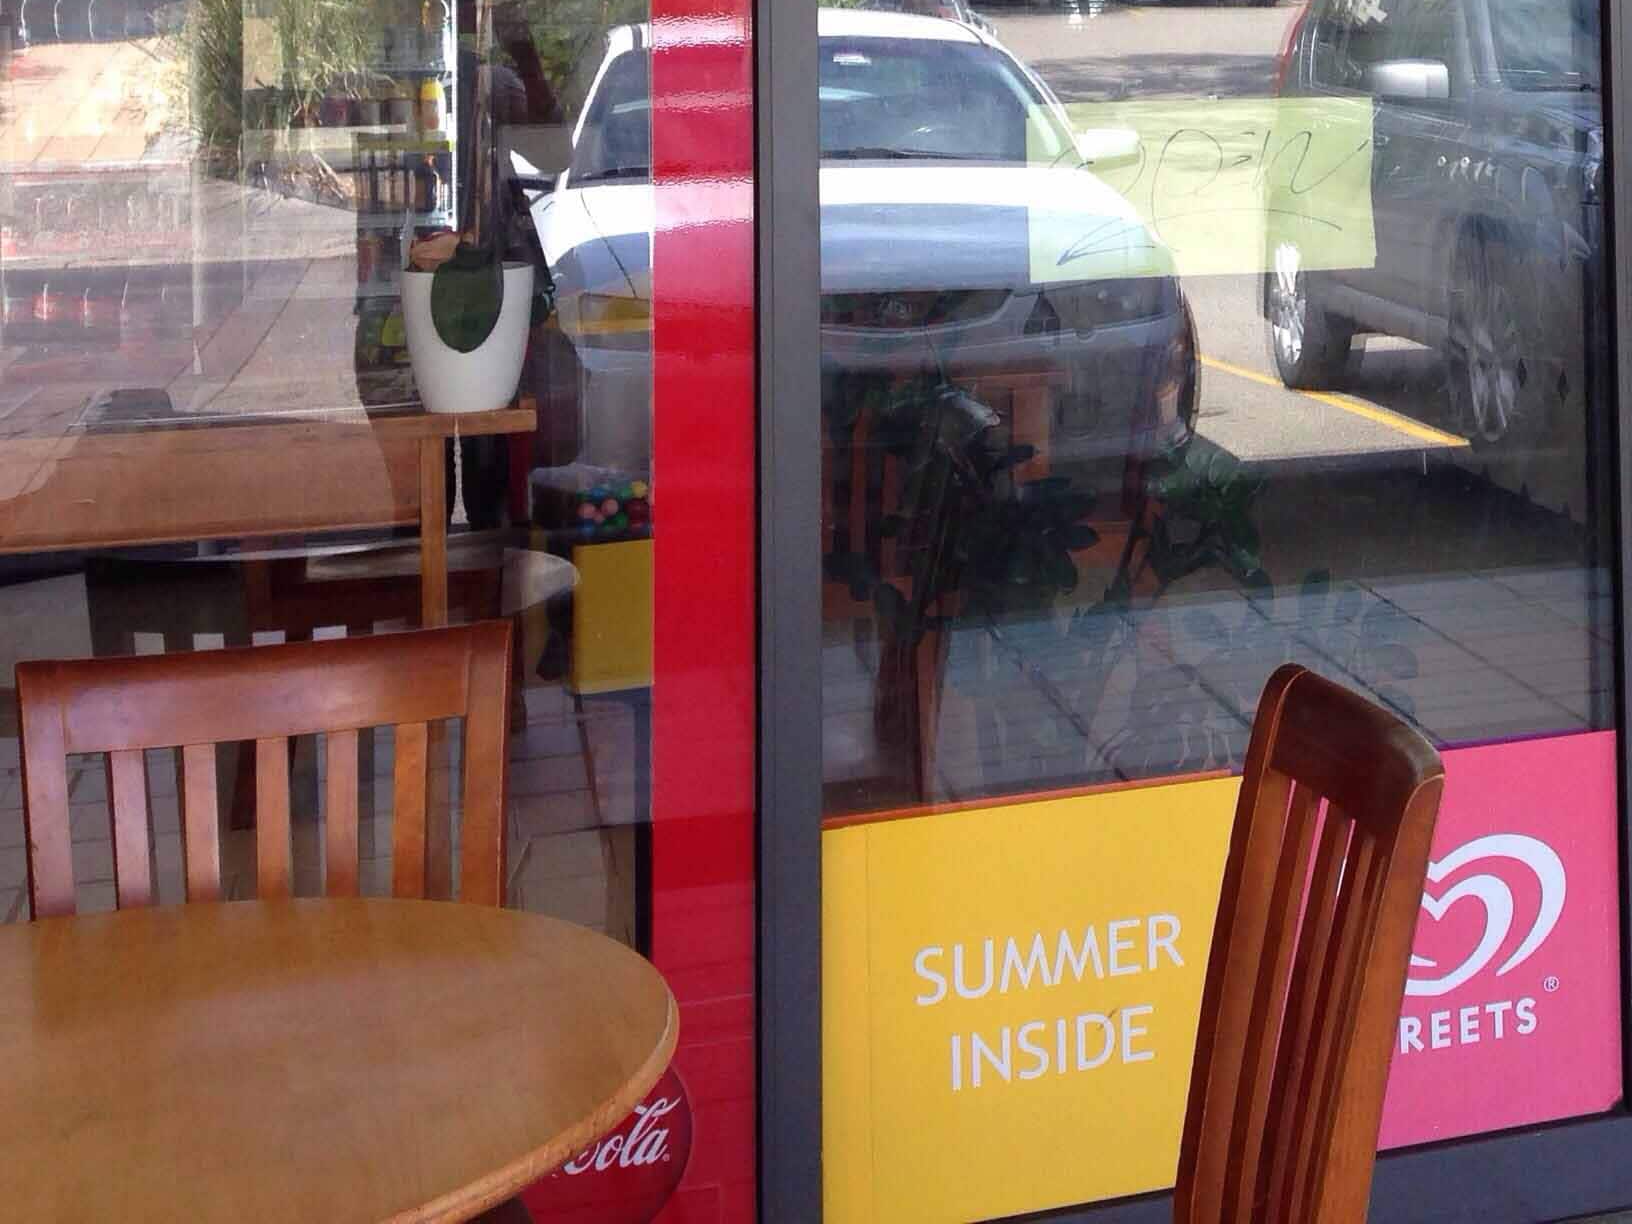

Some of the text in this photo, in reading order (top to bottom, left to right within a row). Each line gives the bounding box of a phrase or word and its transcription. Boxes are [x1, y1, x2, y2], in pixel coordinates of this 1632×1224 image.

[914, 913, 1184, 1005] SUMMER
[951, 1005, 1155, 1091] INSIDE
[1400, 997, 1537, 1054] REETS
